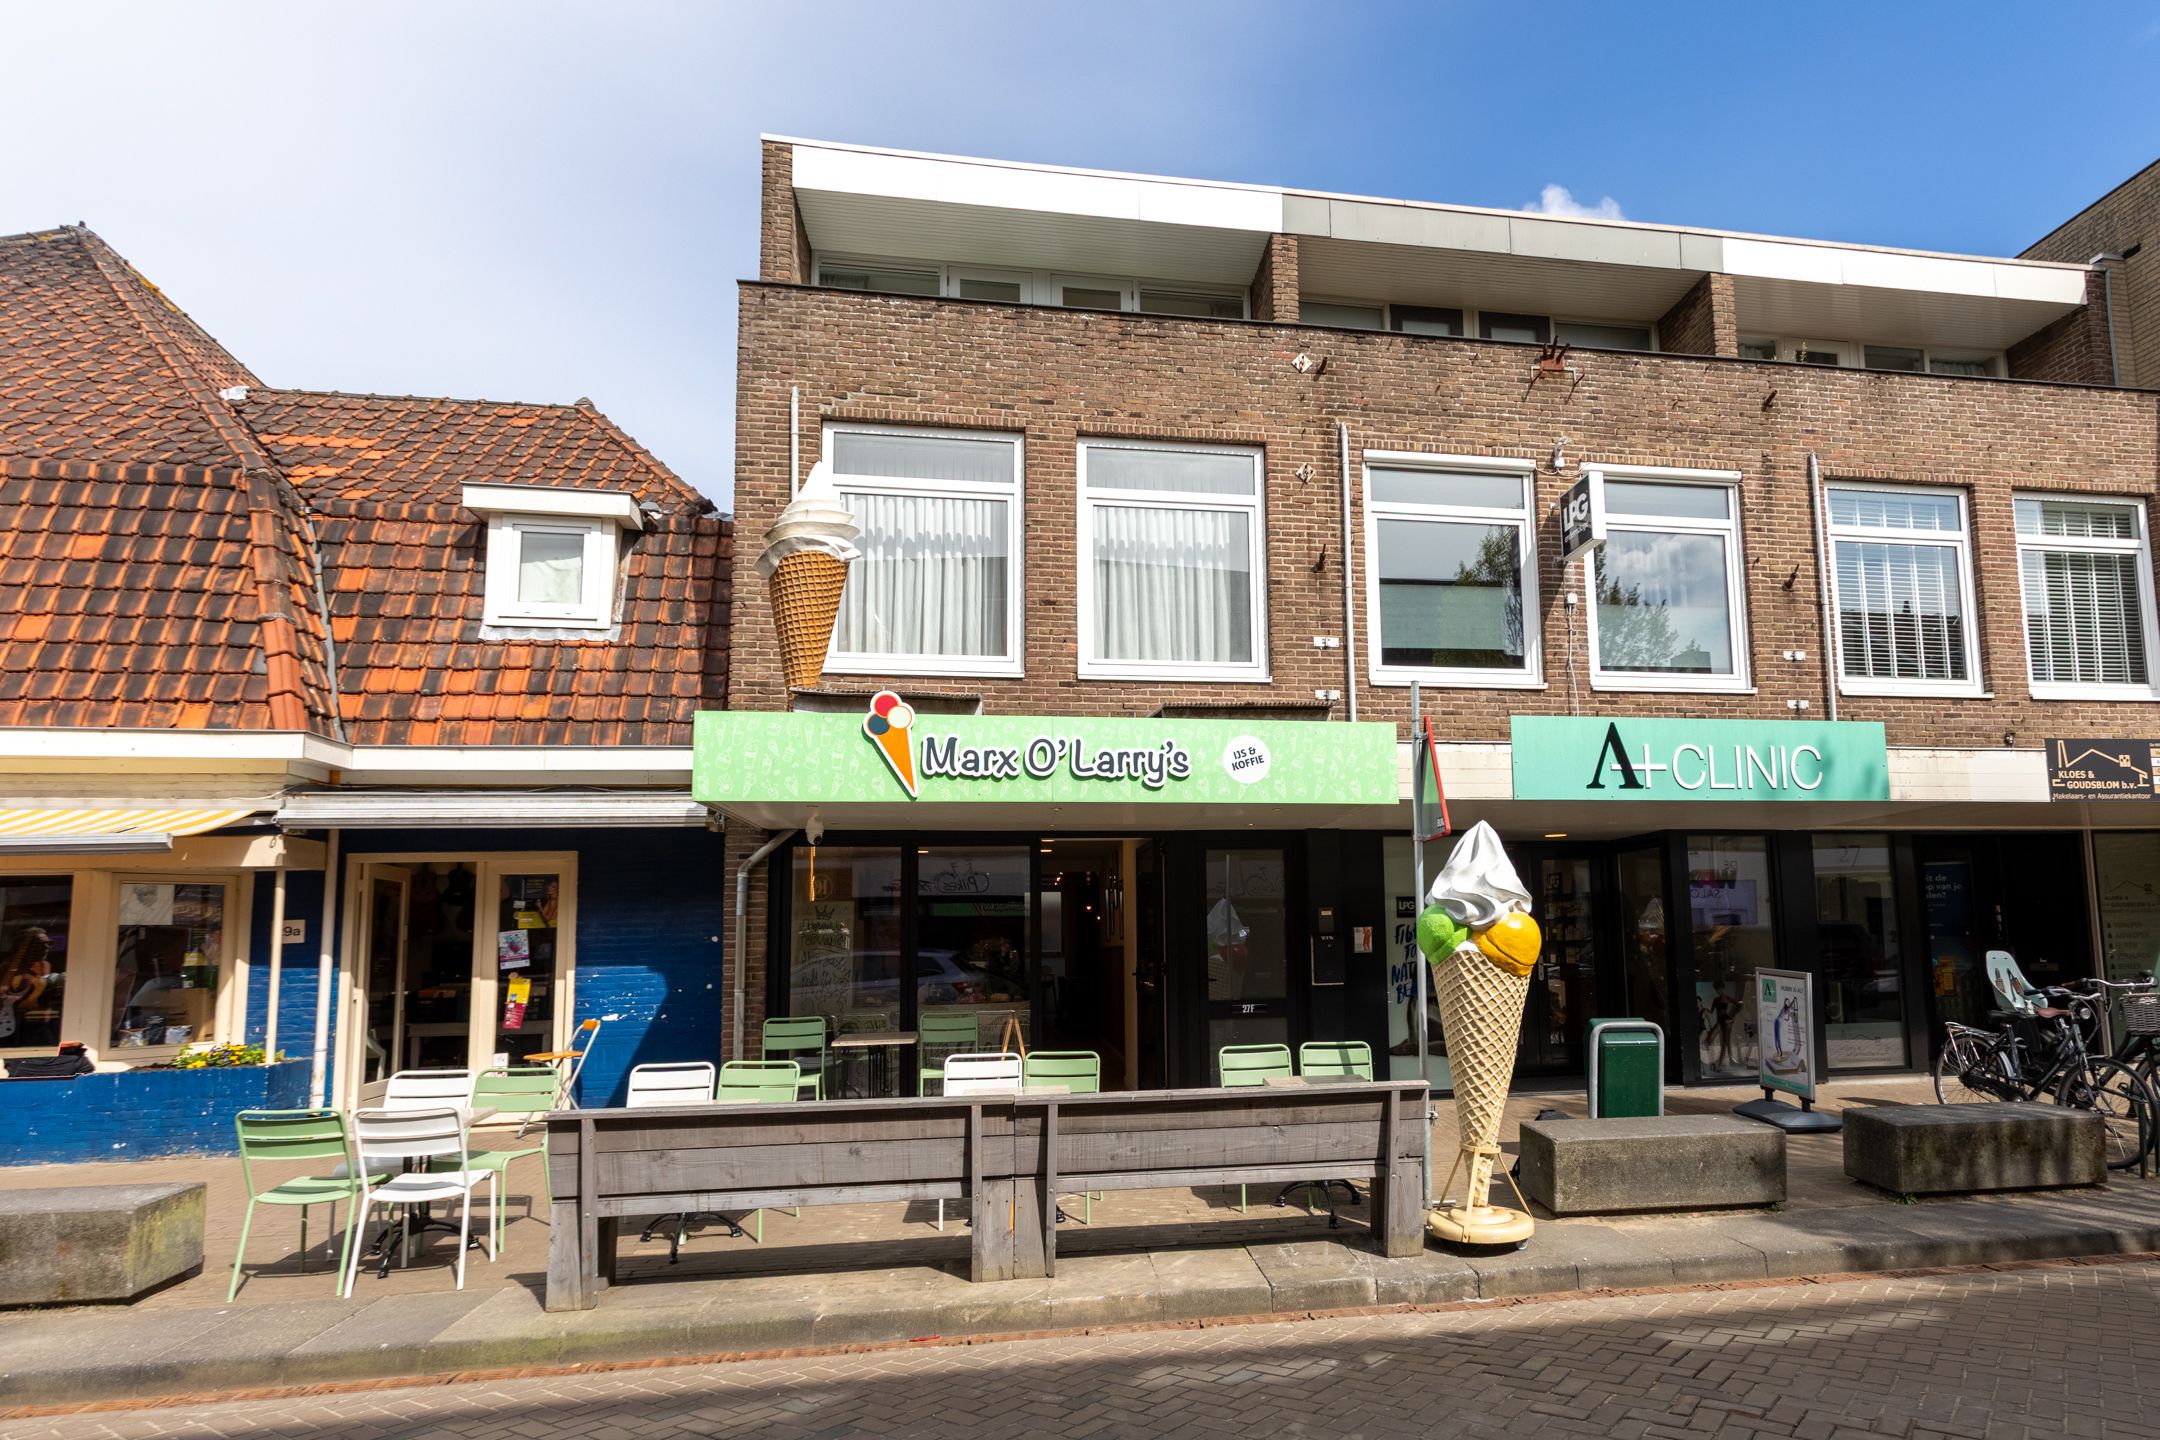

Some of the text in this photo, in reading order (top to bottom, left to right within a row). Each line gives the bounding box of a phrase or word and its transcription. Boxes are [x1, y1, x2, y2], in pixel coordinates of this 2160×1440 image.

[1563, 492, 1588, 532] LPG
[924, 736, 1018, 774] Marx
[1233, 747, 1256, 760] IJS &
[1231, 755, 1265, 771] KOFFIE
[2058, 770, 2095, 779] KLOES &
[2067, 781, 2138, 789] GOUDSBLOM b.v.
[1839, 845, 1861, 867] 27
[1399, 901, 1415, 910] LPG
[282, 926, 301, 937] 9a
[1242, 1004, 1255, 1013] 27F
